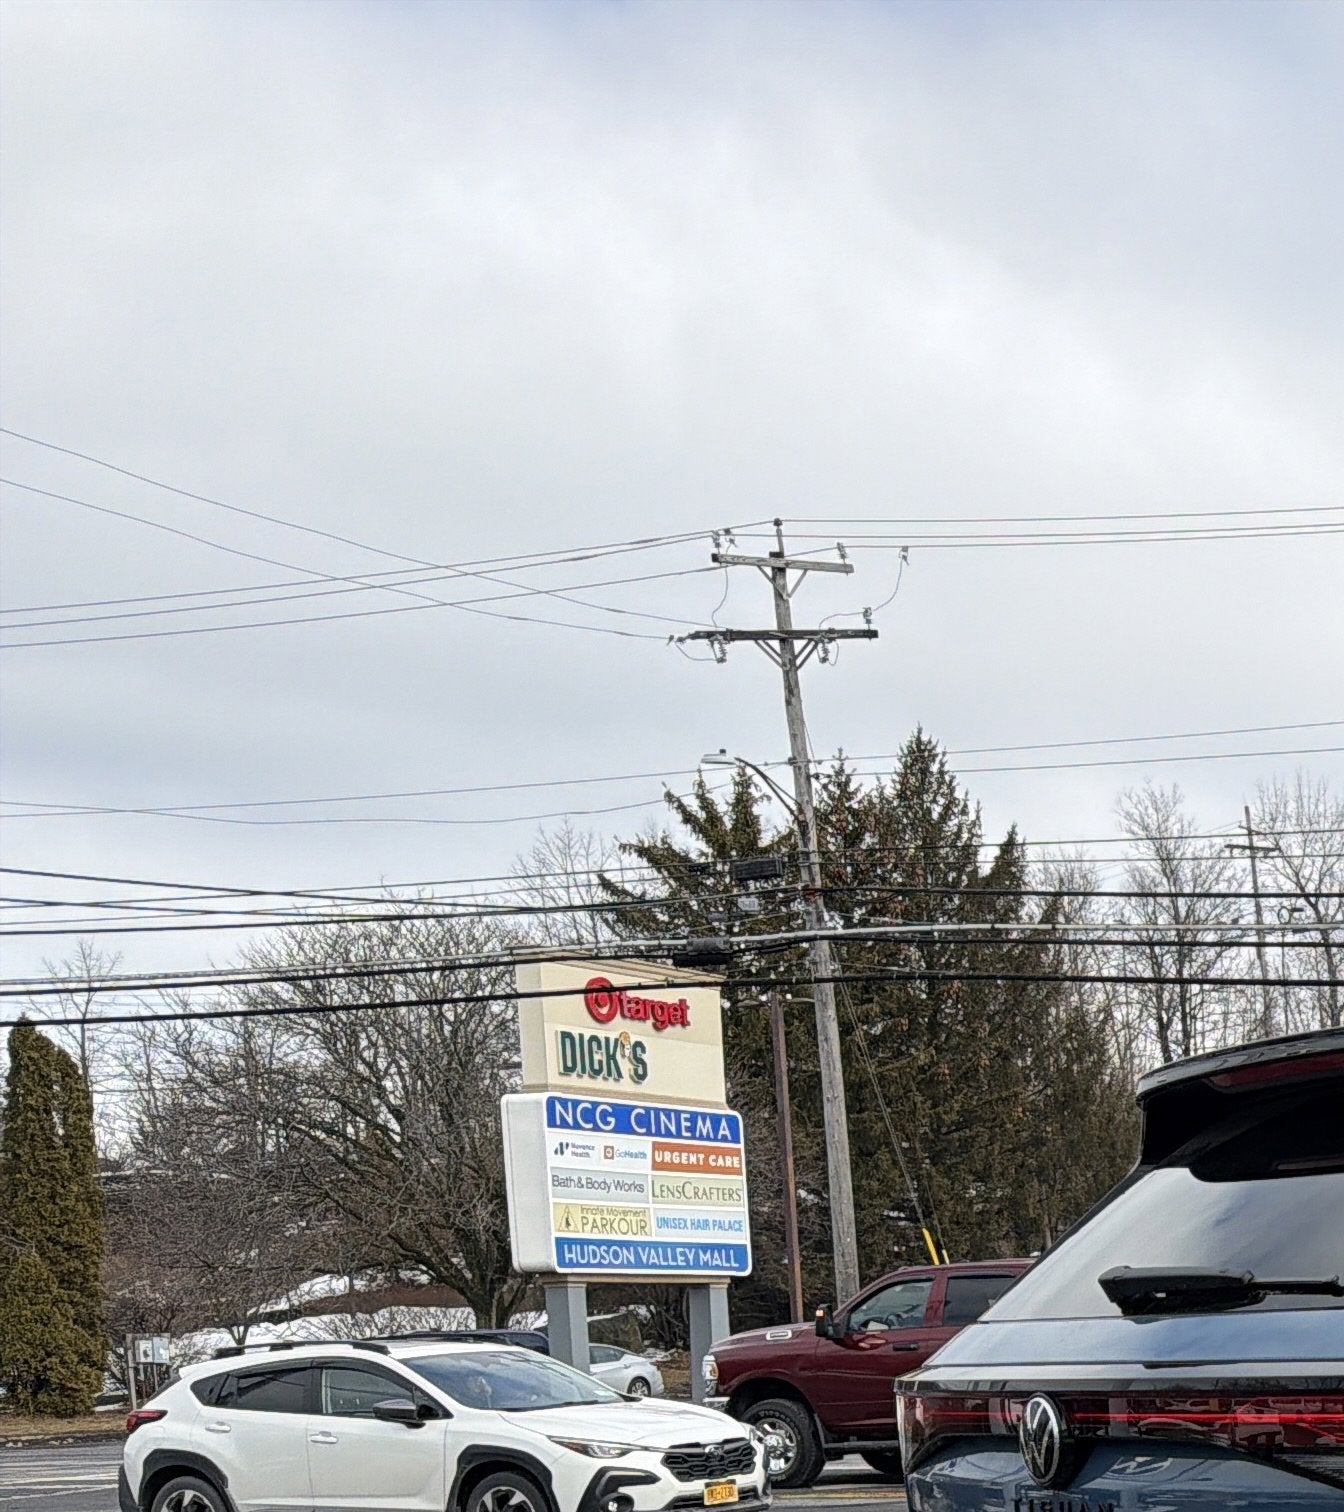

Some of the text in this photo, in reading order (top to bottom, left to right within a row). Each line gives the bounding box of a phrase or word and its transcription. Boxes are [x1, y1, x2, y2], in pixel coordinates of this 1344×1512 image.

[619, 991, 690, 1030] target
[558, 1030, 648, 1082] DICK'S
[554, 1099, 732, 1140] NCG CINEMA
[615, 1149, 647, 1160] GoHealth
[654, 1150, 741, 1168] URGENT CARE
[552, 1174, 645, 1194] Bath & Body Works
[606, 1208, 647, 1217] Movement
[581, 1216, 648, 1236] PARKOUR
[656, 1216, 744, 1233] UNISEX HAIR PALACE
[564, 1244, 740, 1268] HUDSON VALLEY MALL
